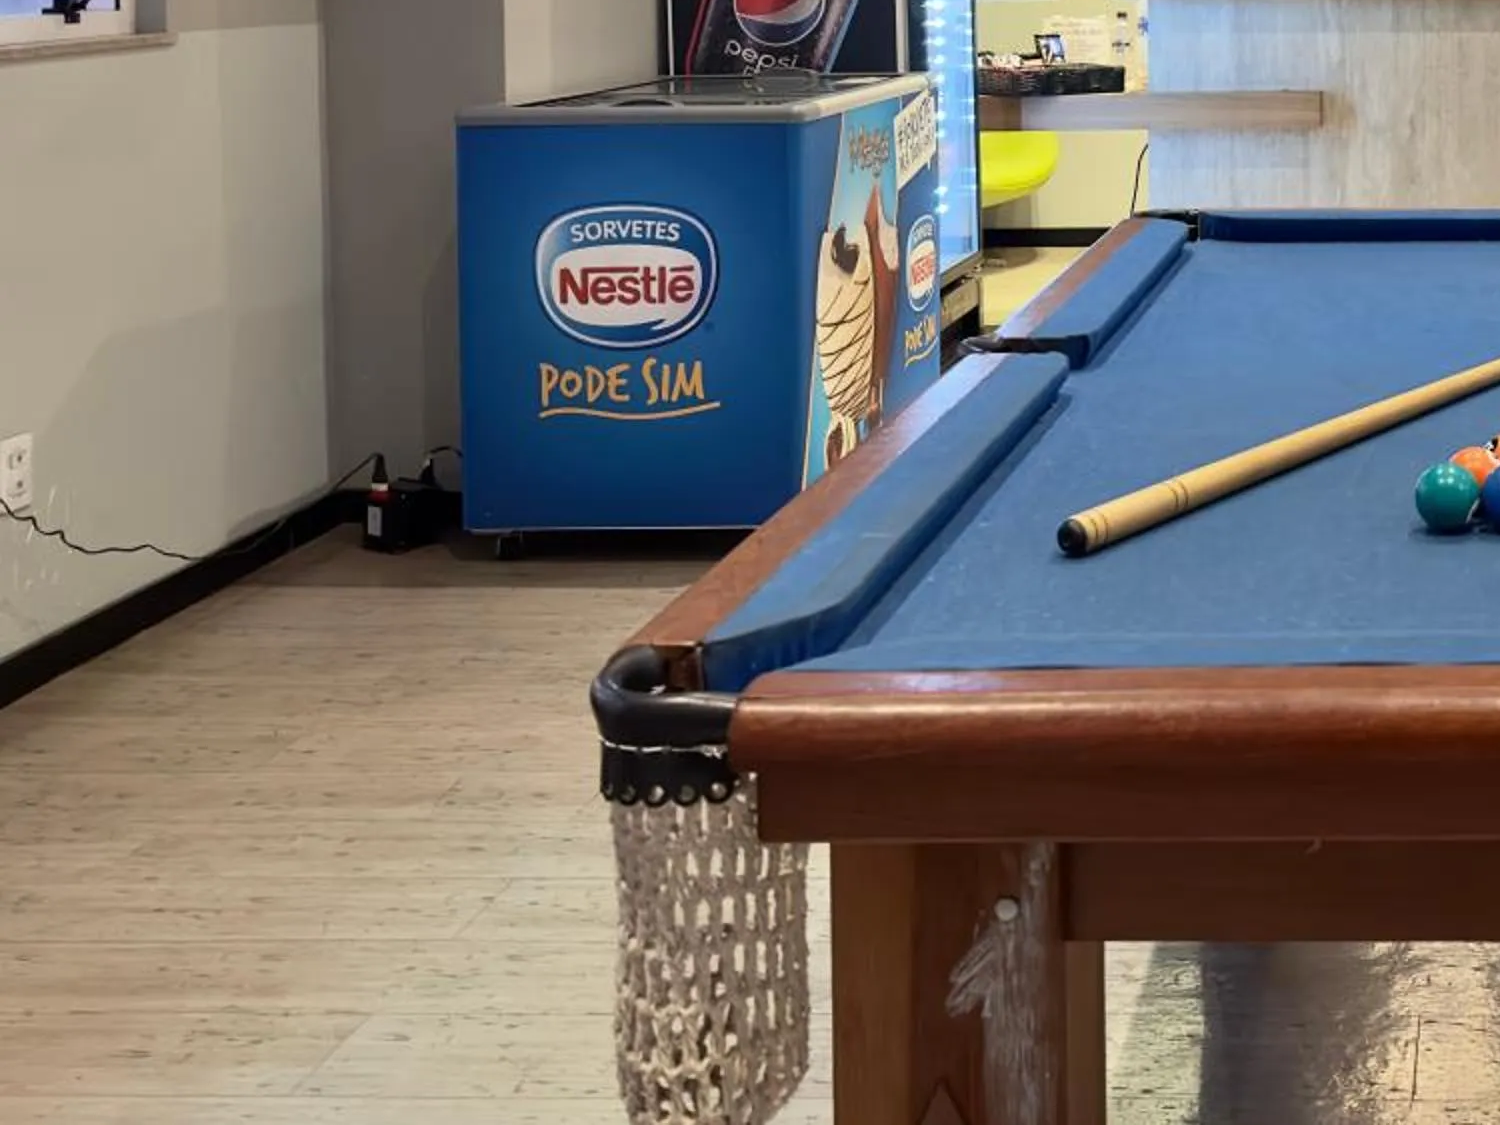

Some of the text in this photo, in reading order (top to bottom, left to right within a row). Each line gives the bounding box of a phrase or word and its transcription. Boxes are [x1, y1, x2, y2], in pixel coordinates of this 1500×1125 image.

[724, 40, 799, 74] pepsi
[571, 220, 681, 243] SORVETES
[559, 265, 695, 305] Nestlé
[540, 358, 706, 407] PODE SIM
